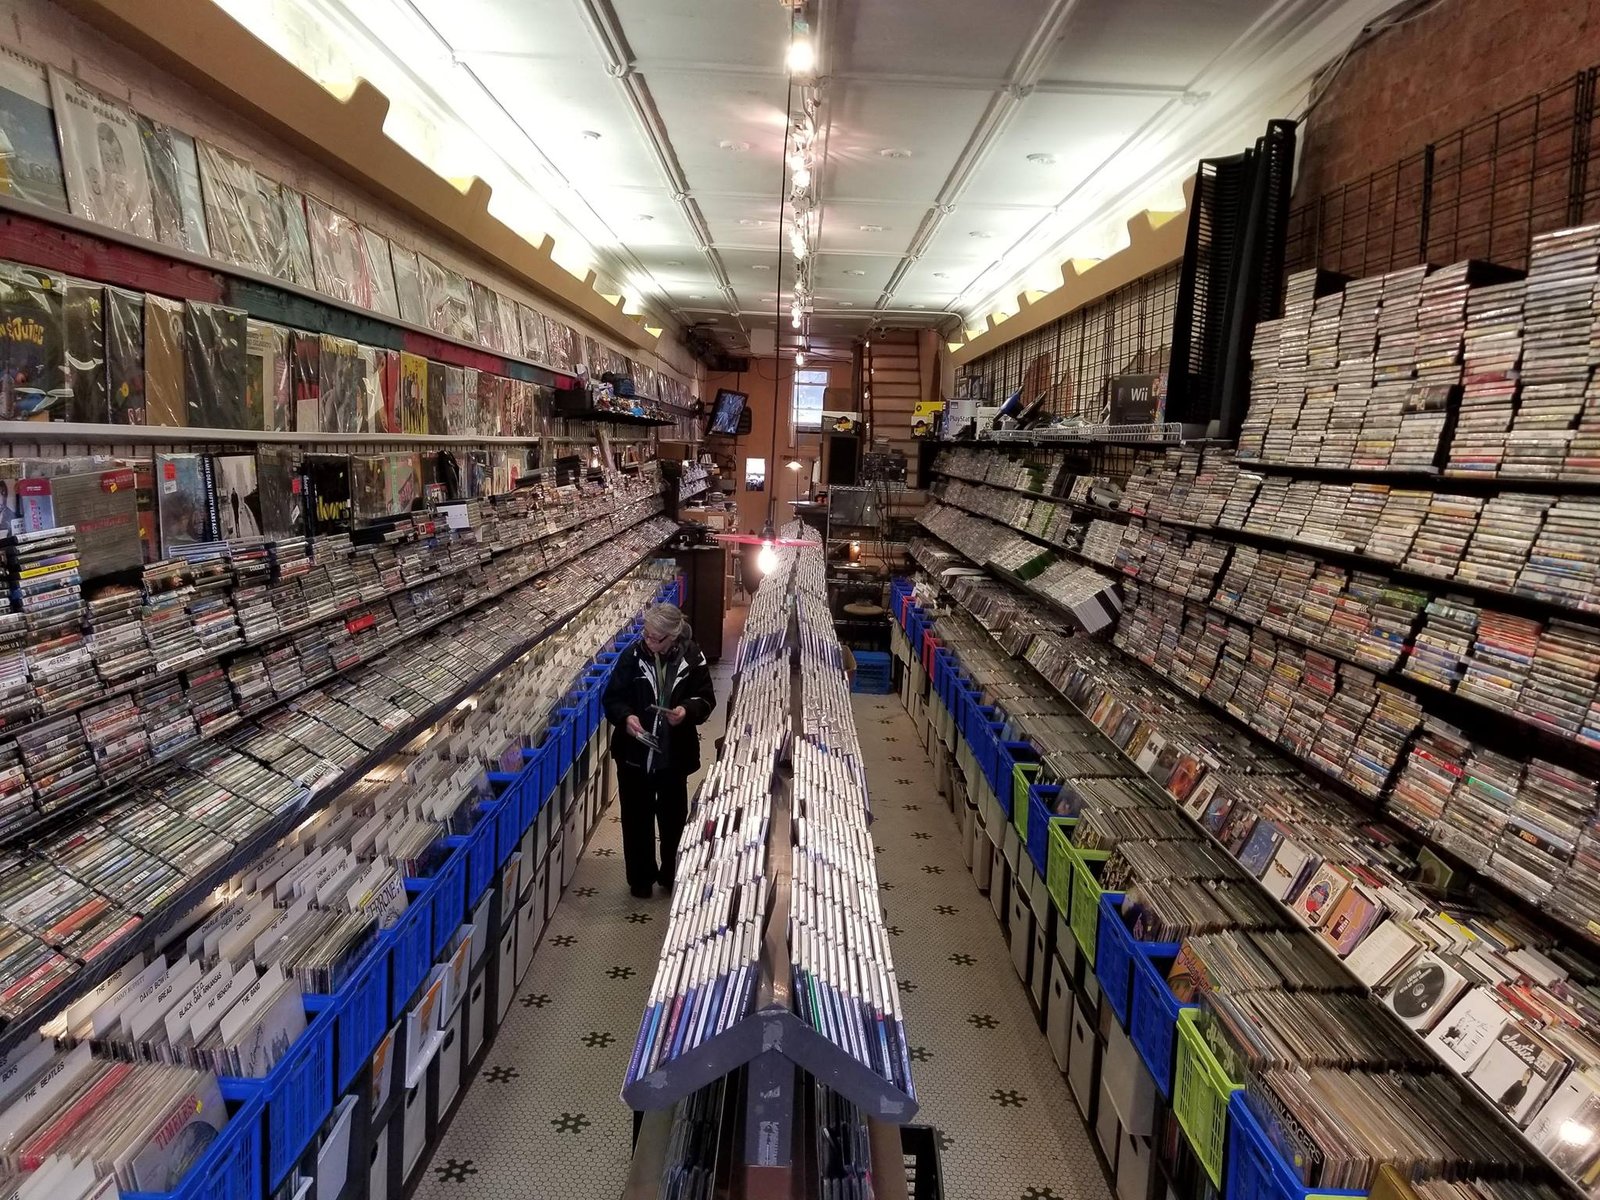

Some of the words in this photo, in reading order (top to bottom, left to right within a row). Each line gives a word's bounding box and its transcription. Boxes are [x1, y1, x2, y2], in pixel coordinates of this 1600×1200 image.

[1131, 387, 1148, 401] Wii
[96, 982, 106, 996] THE
[140, 987, 154, 1002] DAVID
[154, 970, 170, 990] BOWIE
[158, 986, 173, 1003] BREAD
[178, 1002, 192, 1019] BLACK
[194, 992, 202, 1004] OAK
[202, 972, 222, 994] ARKANSAS
[241, 994, 250, 1006] THE
[250, 982, 261, 998] BAND
[207, 998, 216, 1010] PAT
[2, 1064, 18, 1083] BOYS
[24, 1086, 37, 1102] THE
[40, 1061, 65, 1088] BEATLES
[154, 1090, 196, 1151] TIMELESS
[1261, 1080, 1286, 1116] KENNY
[1285, 1114, 1320, 1164] ROGERS
